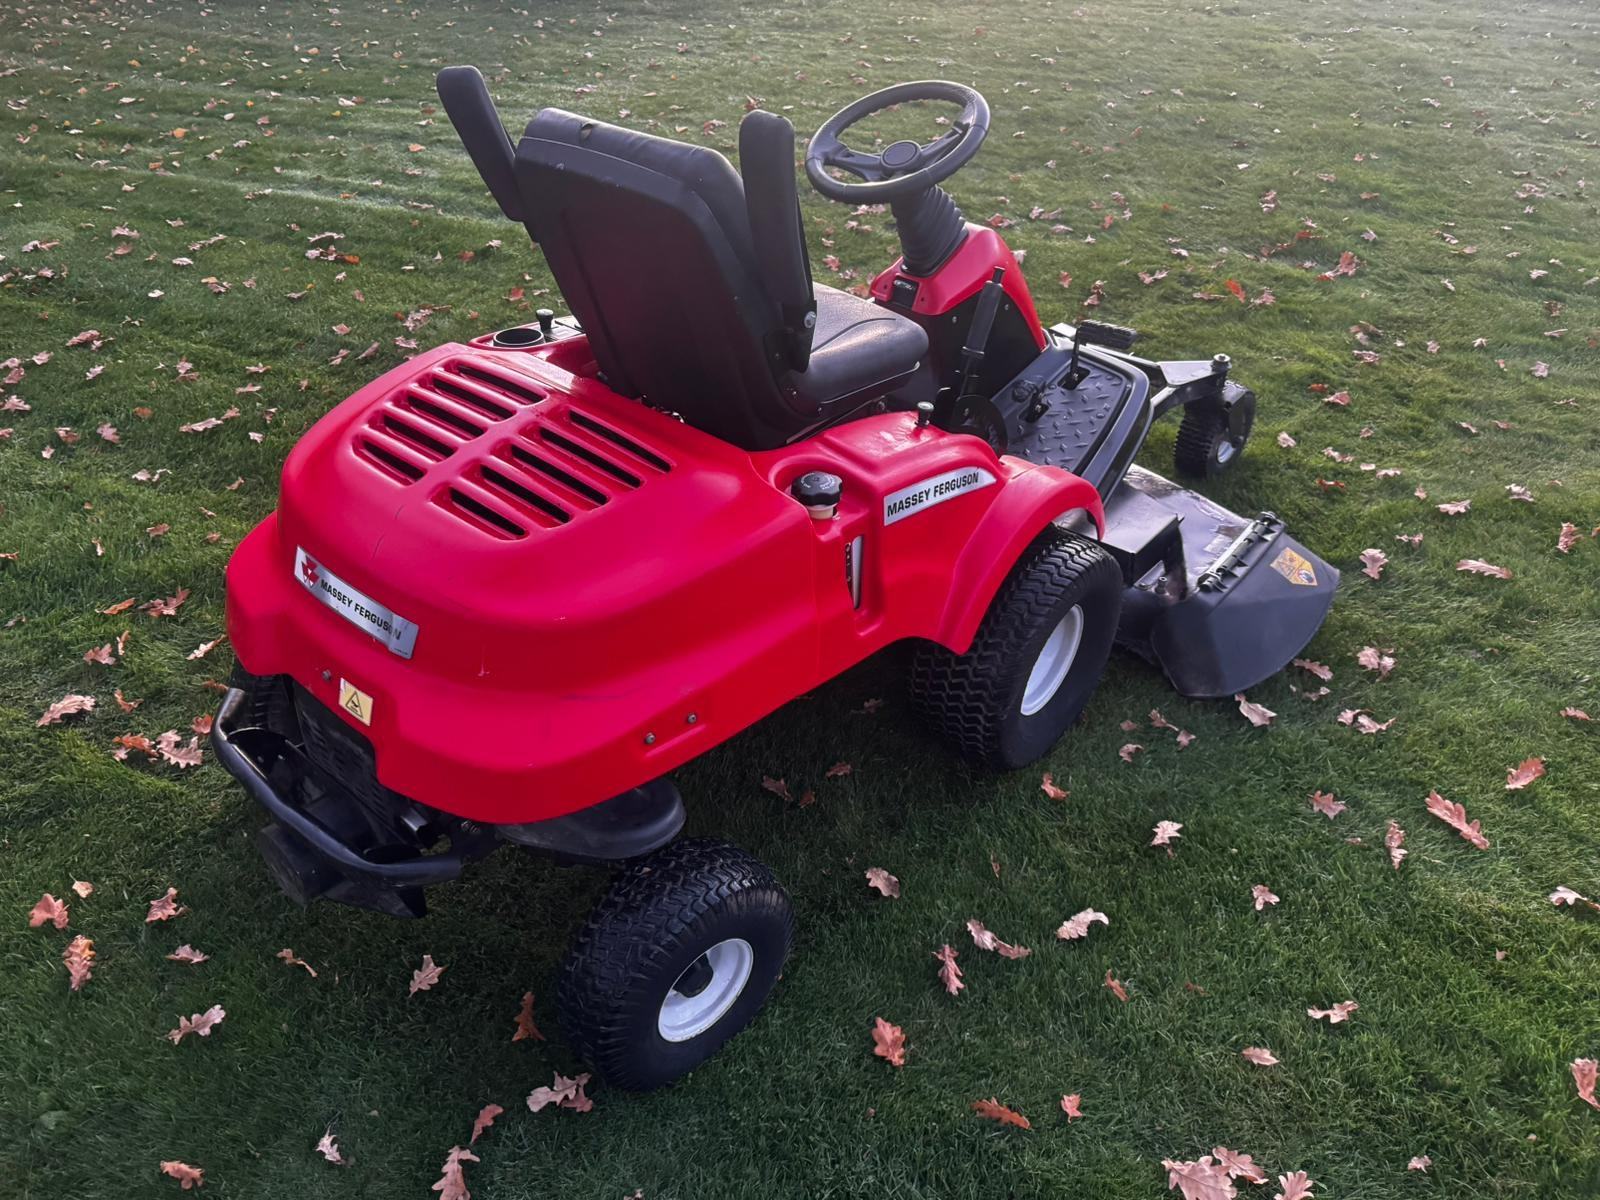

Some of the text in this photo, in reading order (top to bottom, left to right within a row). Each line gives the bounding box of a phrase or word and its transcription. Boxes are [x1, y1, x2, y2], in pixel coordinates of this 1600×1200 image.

[887, 472, 979, 517] MASSEY FERGUSON
[320, 579, 402, 640] MASSEY FERGUSON
